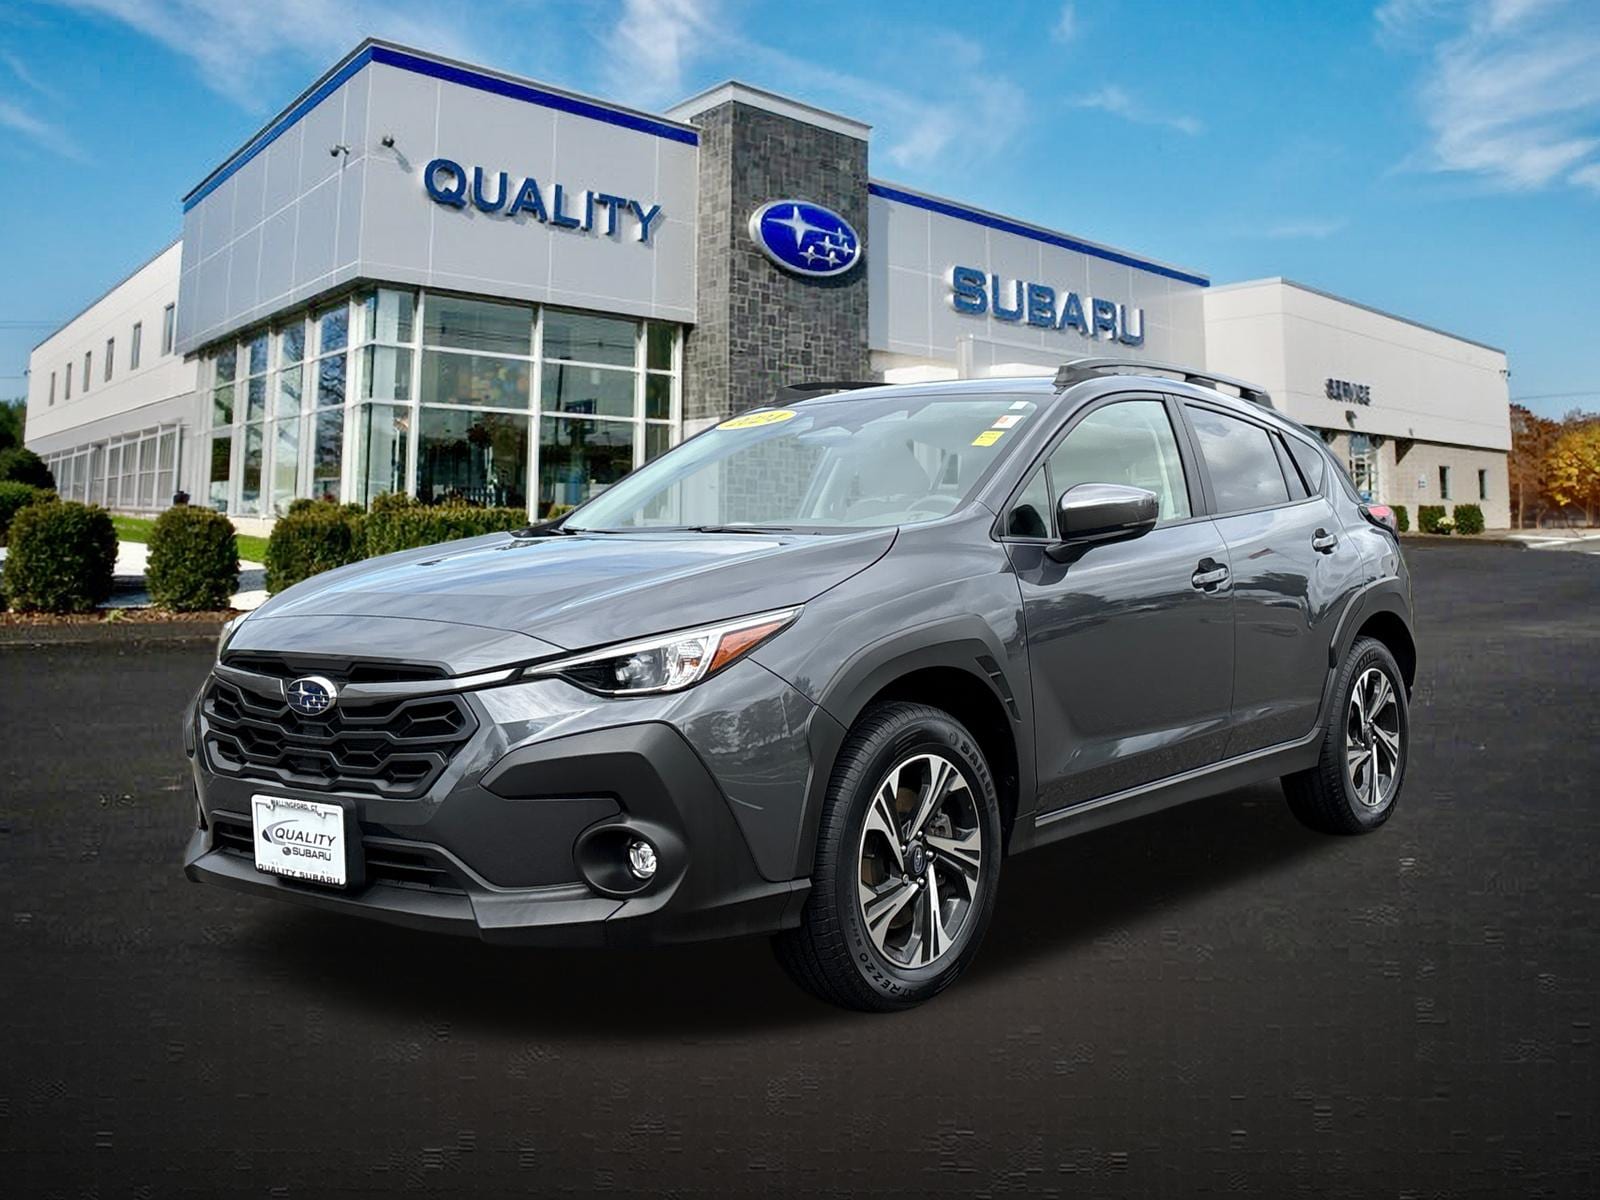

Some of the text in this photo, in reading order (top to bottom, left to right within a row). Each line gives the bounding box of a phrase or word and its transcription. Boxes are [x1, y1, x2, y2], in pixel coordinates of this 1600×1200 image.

[424, 158, 661, 242] QUALITY
[952, 265, 1144, 346] SUBARU
[1325, 378, 1370, 406] SERVICE
[275, 827, 336, 847] QUALITY
[292, 847, 331, 861] SUBARU
[258, 863, 296, 877] QUALITY
[299, 871, 340, 884] SUBARU
